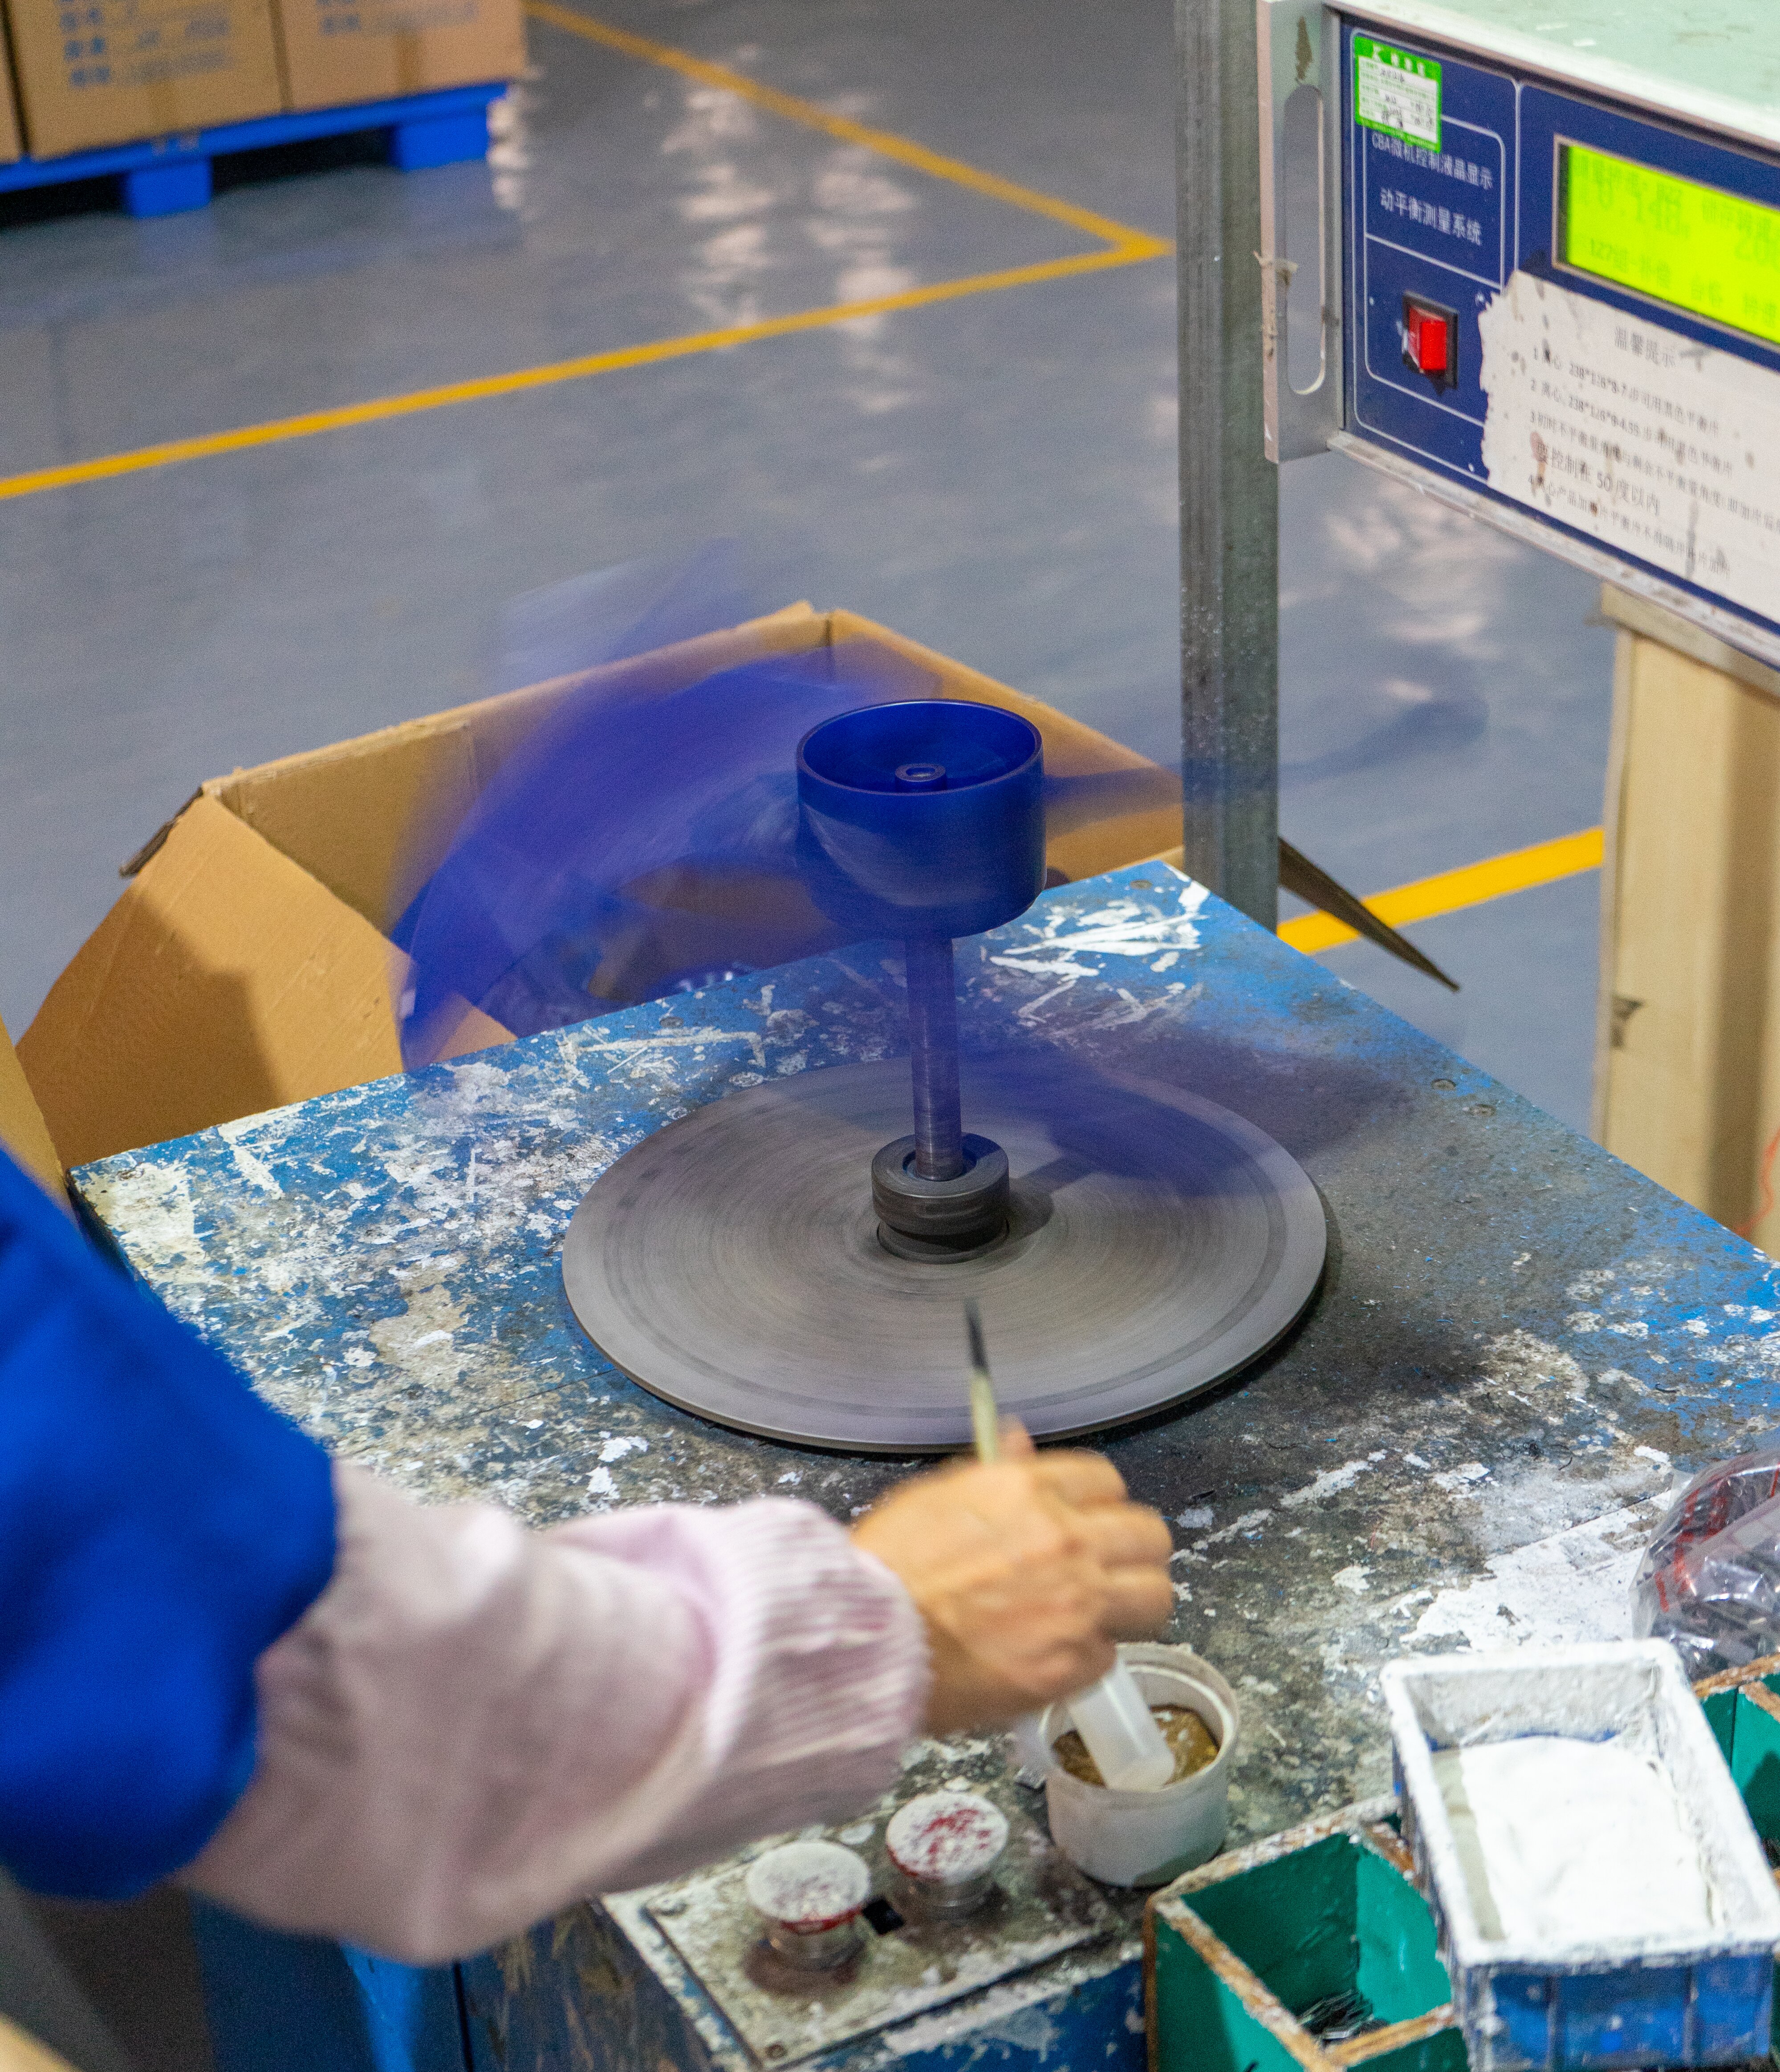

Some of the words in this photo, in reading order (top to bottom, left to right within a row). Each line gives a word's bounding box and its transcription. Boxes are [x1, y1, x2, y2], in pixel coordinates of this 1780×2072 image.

[1381, 187, 1482, 246] 动平衡测量系统
[1614, 326, 1675, 369] 温馨提示
[1597, 471, 1613, 492] 50
